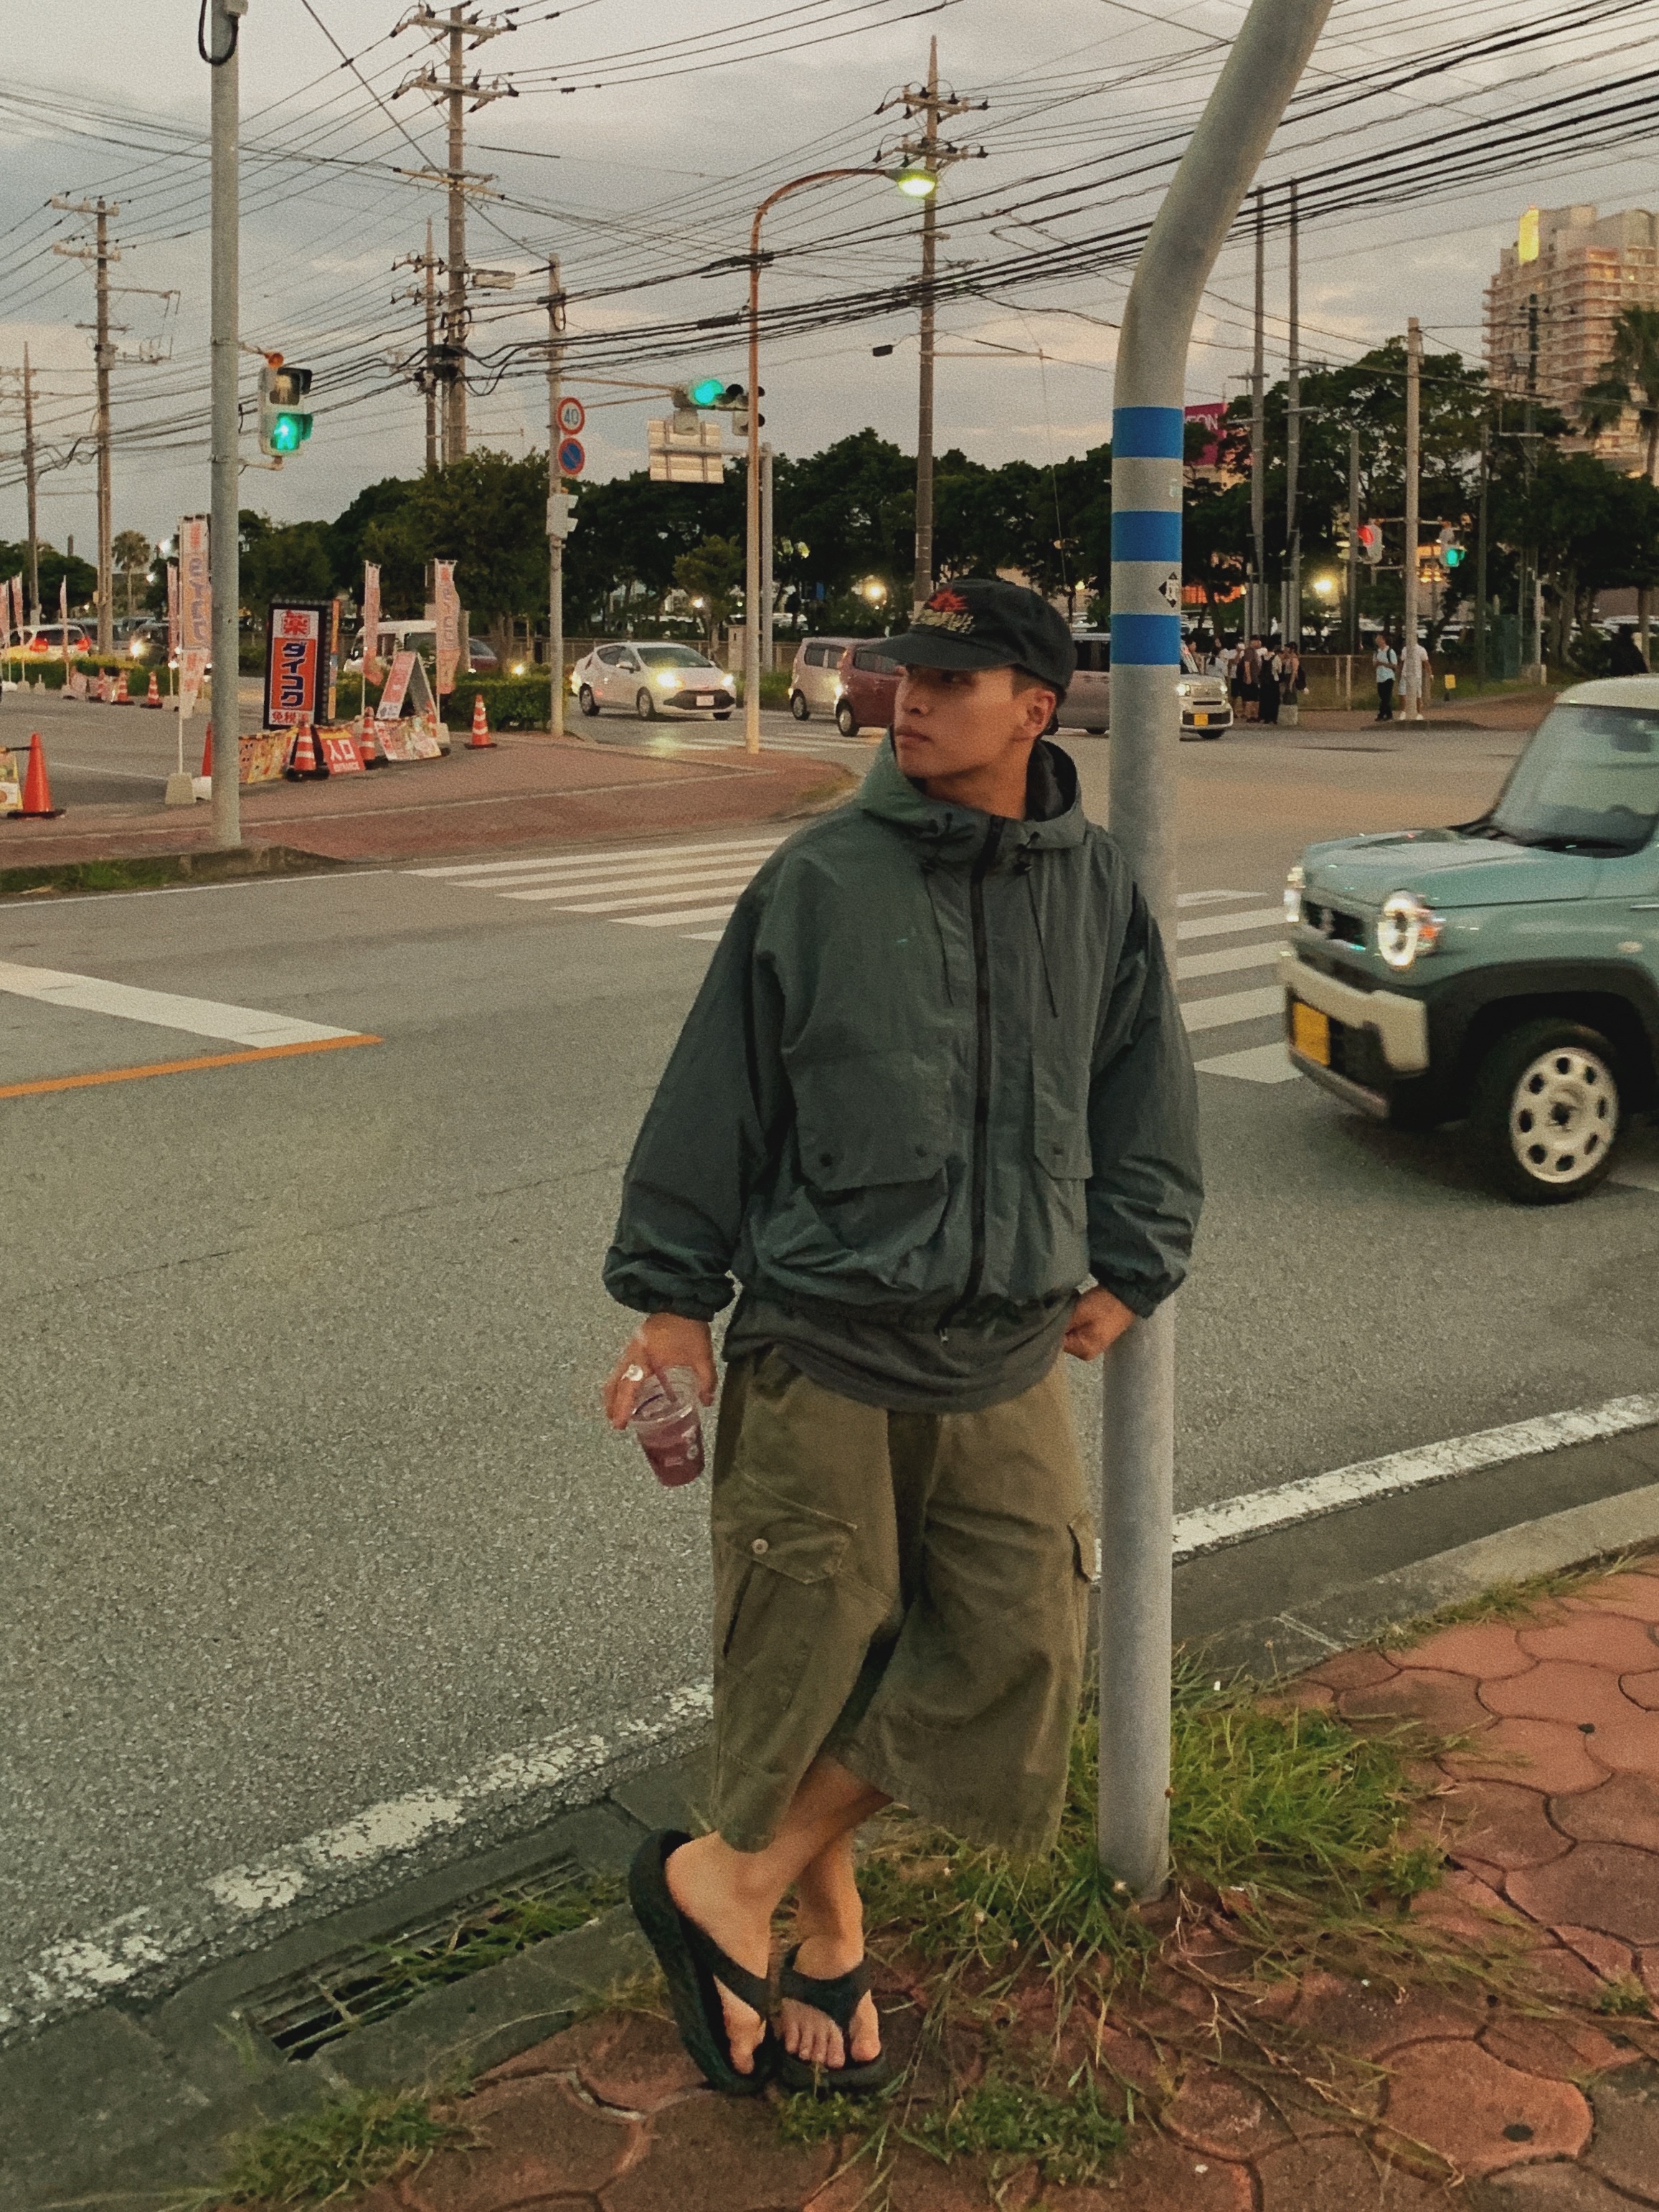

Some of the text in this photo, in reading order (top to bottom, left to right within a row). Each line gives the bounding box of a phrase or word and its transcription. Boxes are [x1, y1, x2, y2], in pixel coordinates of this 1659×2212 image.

[564, 408, 580, 425] 40
[280, 641, 307, 707] ダイコク
[326, 739, 356, 761] 入口
